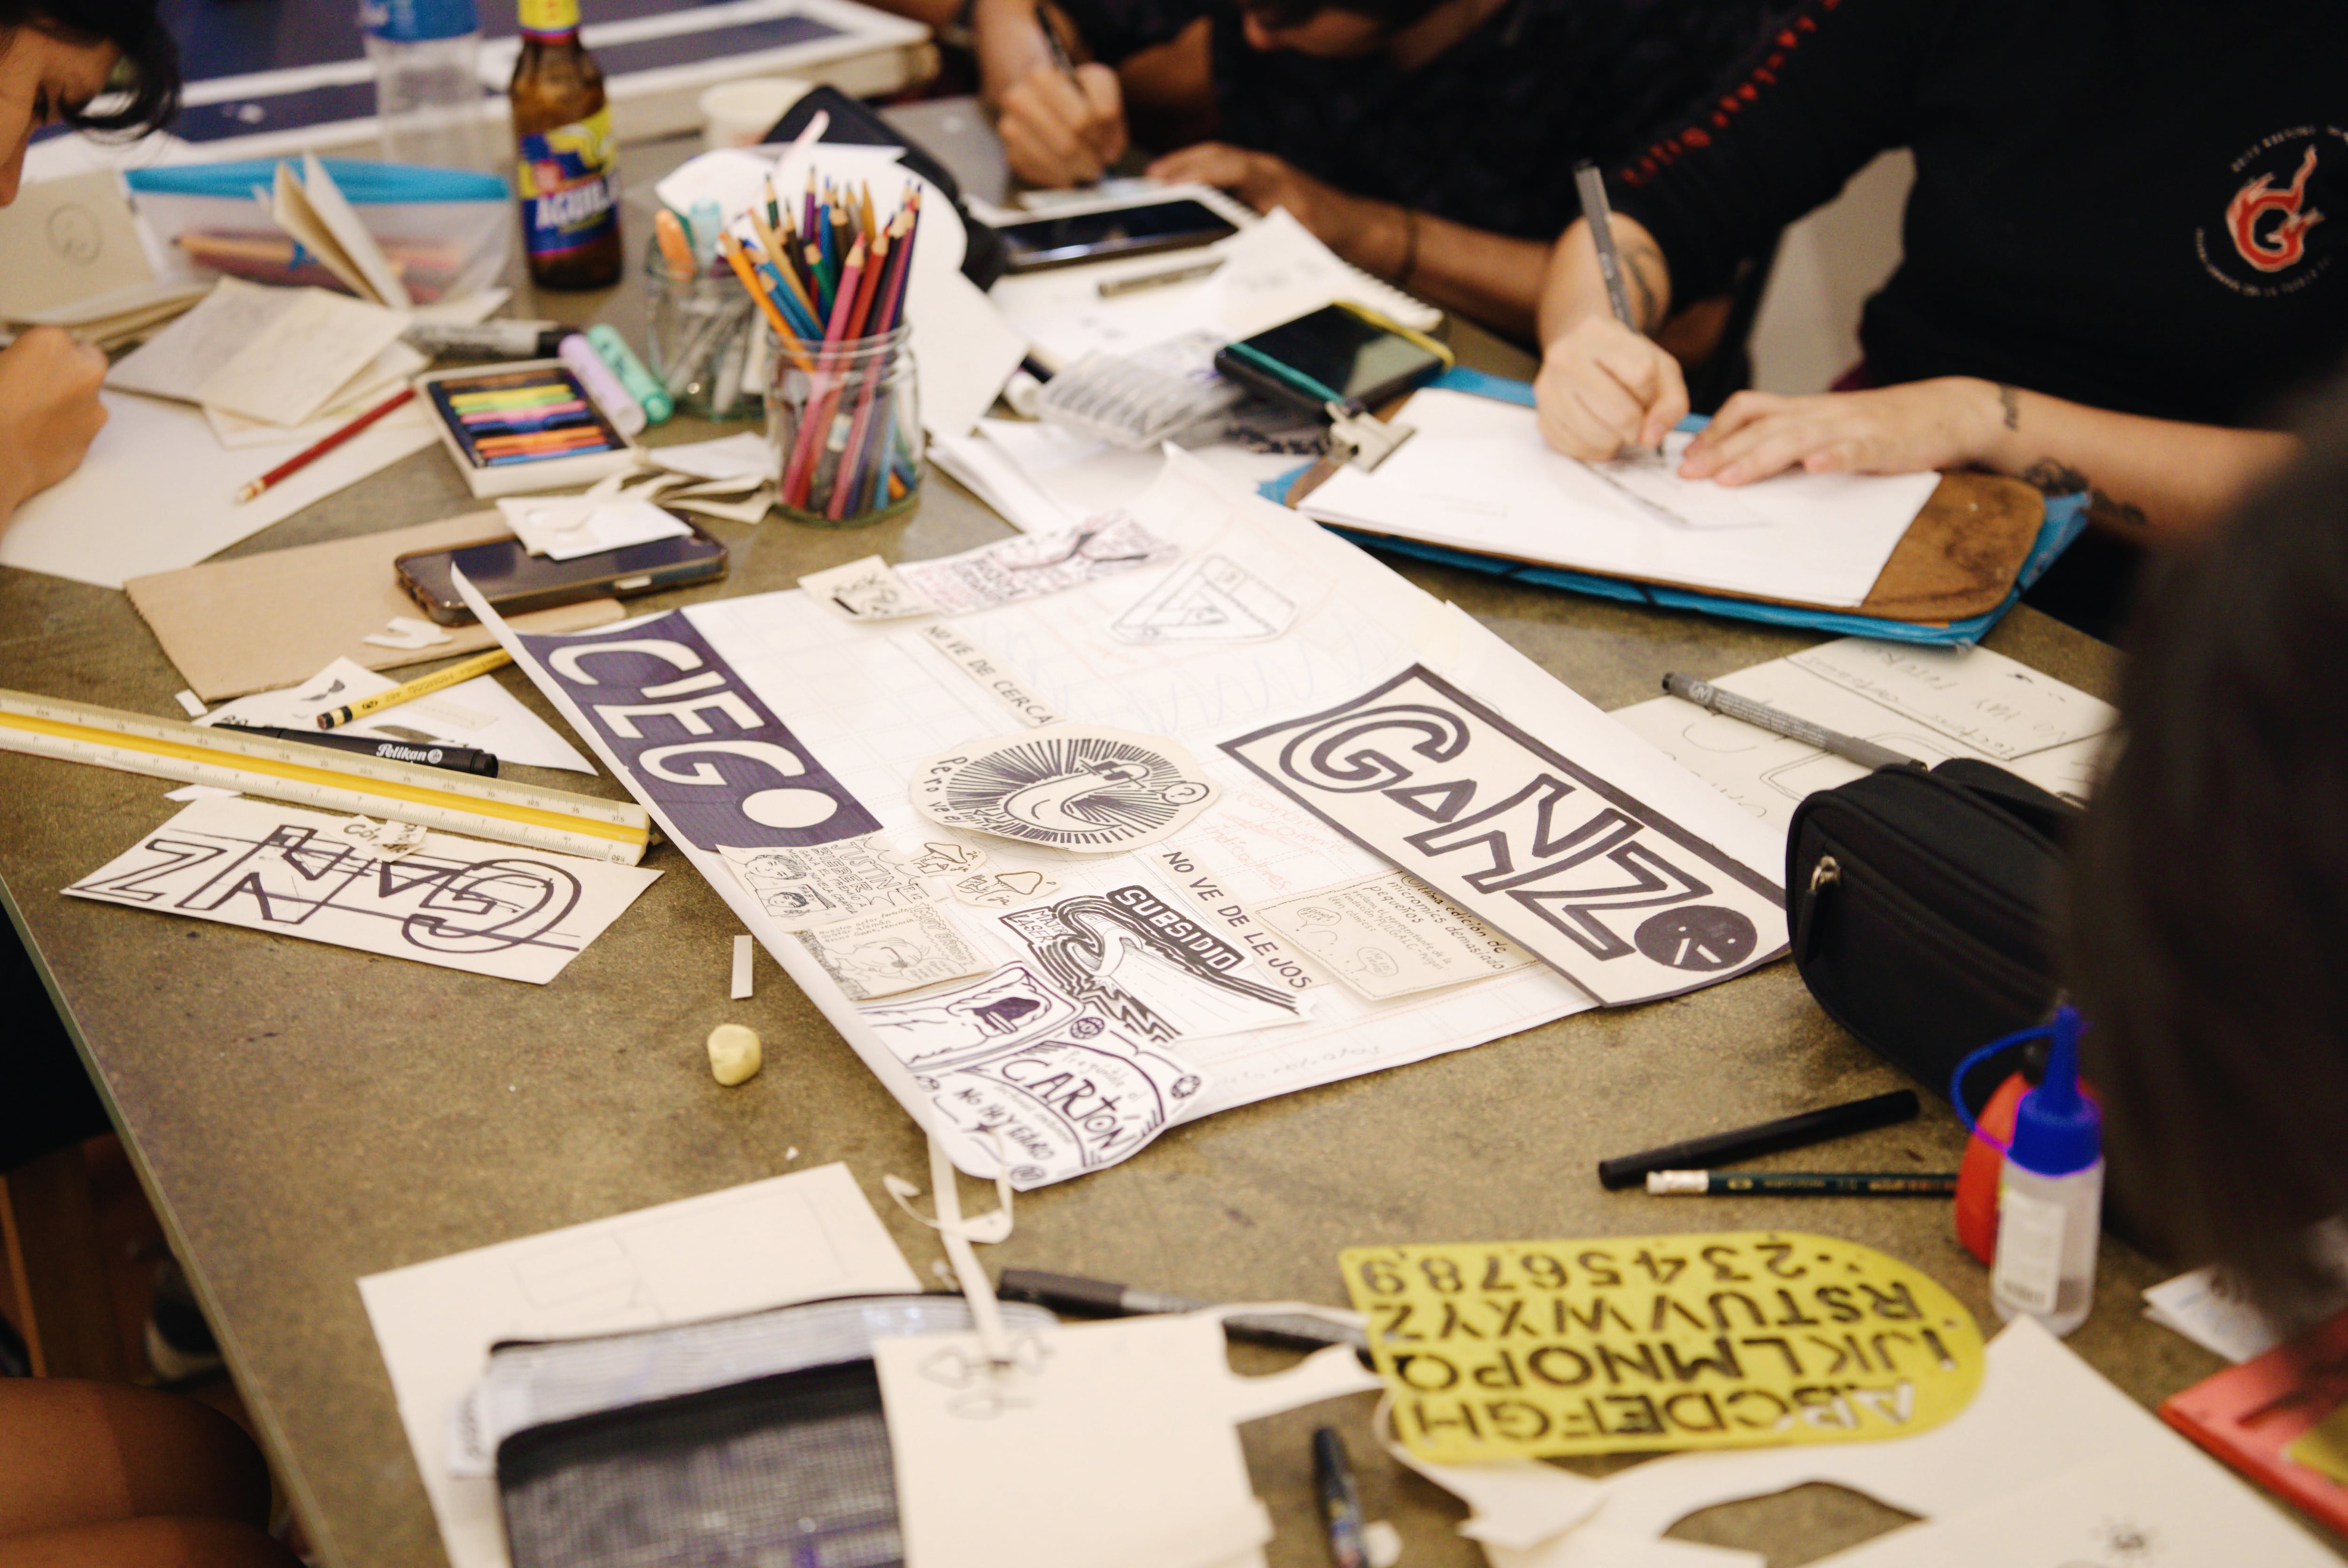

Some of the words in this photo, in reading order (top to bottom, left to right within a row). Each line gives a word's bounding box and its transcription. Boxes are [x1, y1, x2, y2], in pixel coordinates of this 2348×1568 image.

[966, 660, 996, 677] DE
[992, 680, 1055, 725] CERCA
[376, 743, 427, 761] Pelikan
[923, 756, 968, 792] Pero
[611, 854, 626, 862] 1:50
[799, 850, 820, 867] GANA
[811, 847, 873, 893] BIEBER
[831, 841, 902, 890] JUSTIN
[798, 886, 818, 902] BABY
[808, 872, 833, 894] NOVELA
[987, 895, 1011, 906] ja
[1341, 892, 1377, 922] fundación
[1367, 885, 1426, 924] pequeños
[819, 924, 851, 935] Nuestro
[915, 905, 946, 930] MUY
[1009, 914, 1055, 943] LASER
[1031, 909, 1070, 936] MAJOR
[1116, 889, 1237, 970] SUBSIDIO
[1161, 851, 1195, 873] NO
[1189, 876, 1224, 901] VE
[1217, 905, 1250, 928] DE
[1243, 931, 1312, 989] LEJOS
[1386, 880, 1447, 924] micromics
[1444, 925, 1504, 970] demasiado
[1446, 905, 1487, 938] edición
[1487, 939, 1508, 954] de
